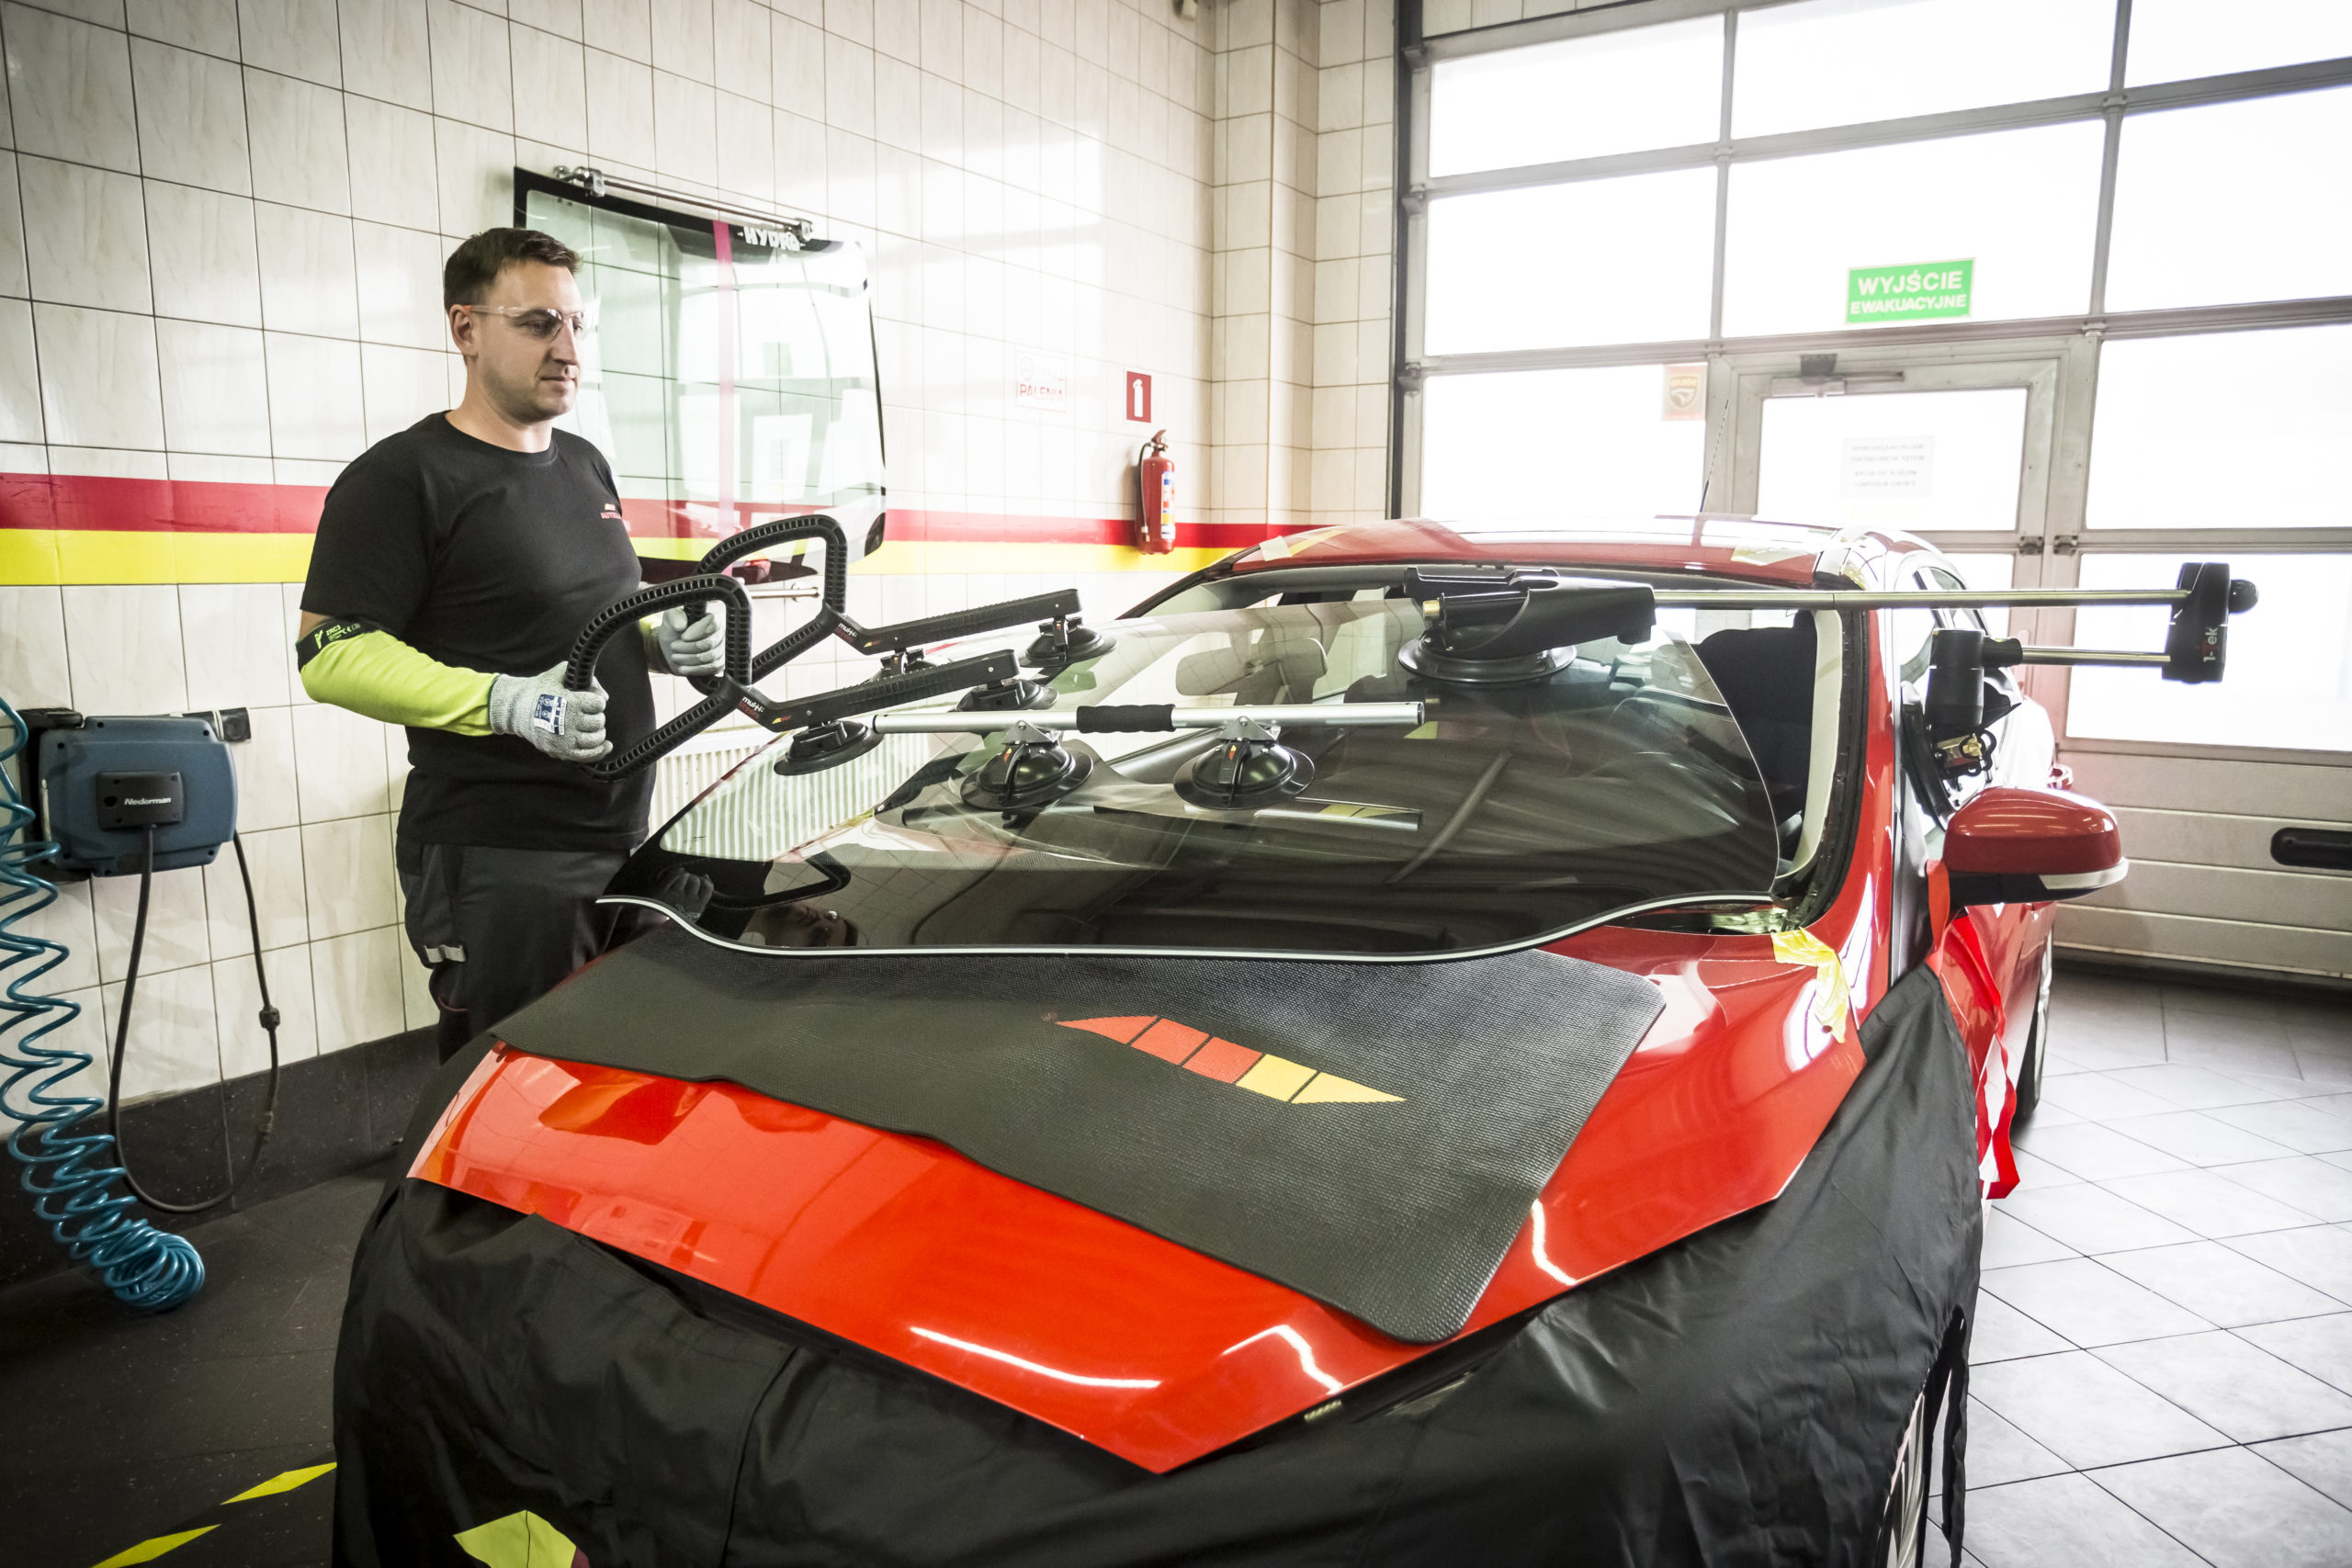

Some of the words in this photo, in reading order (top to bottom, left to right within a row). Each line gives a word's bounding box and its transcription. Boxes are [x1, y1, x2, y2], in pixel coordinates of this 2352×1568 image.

[1858, 269, 1963, 296] WYJŚCIE
[1849, 294, 1967, 314] EWAKUACYJNE
[124, 797, 172, 806] Nederman
